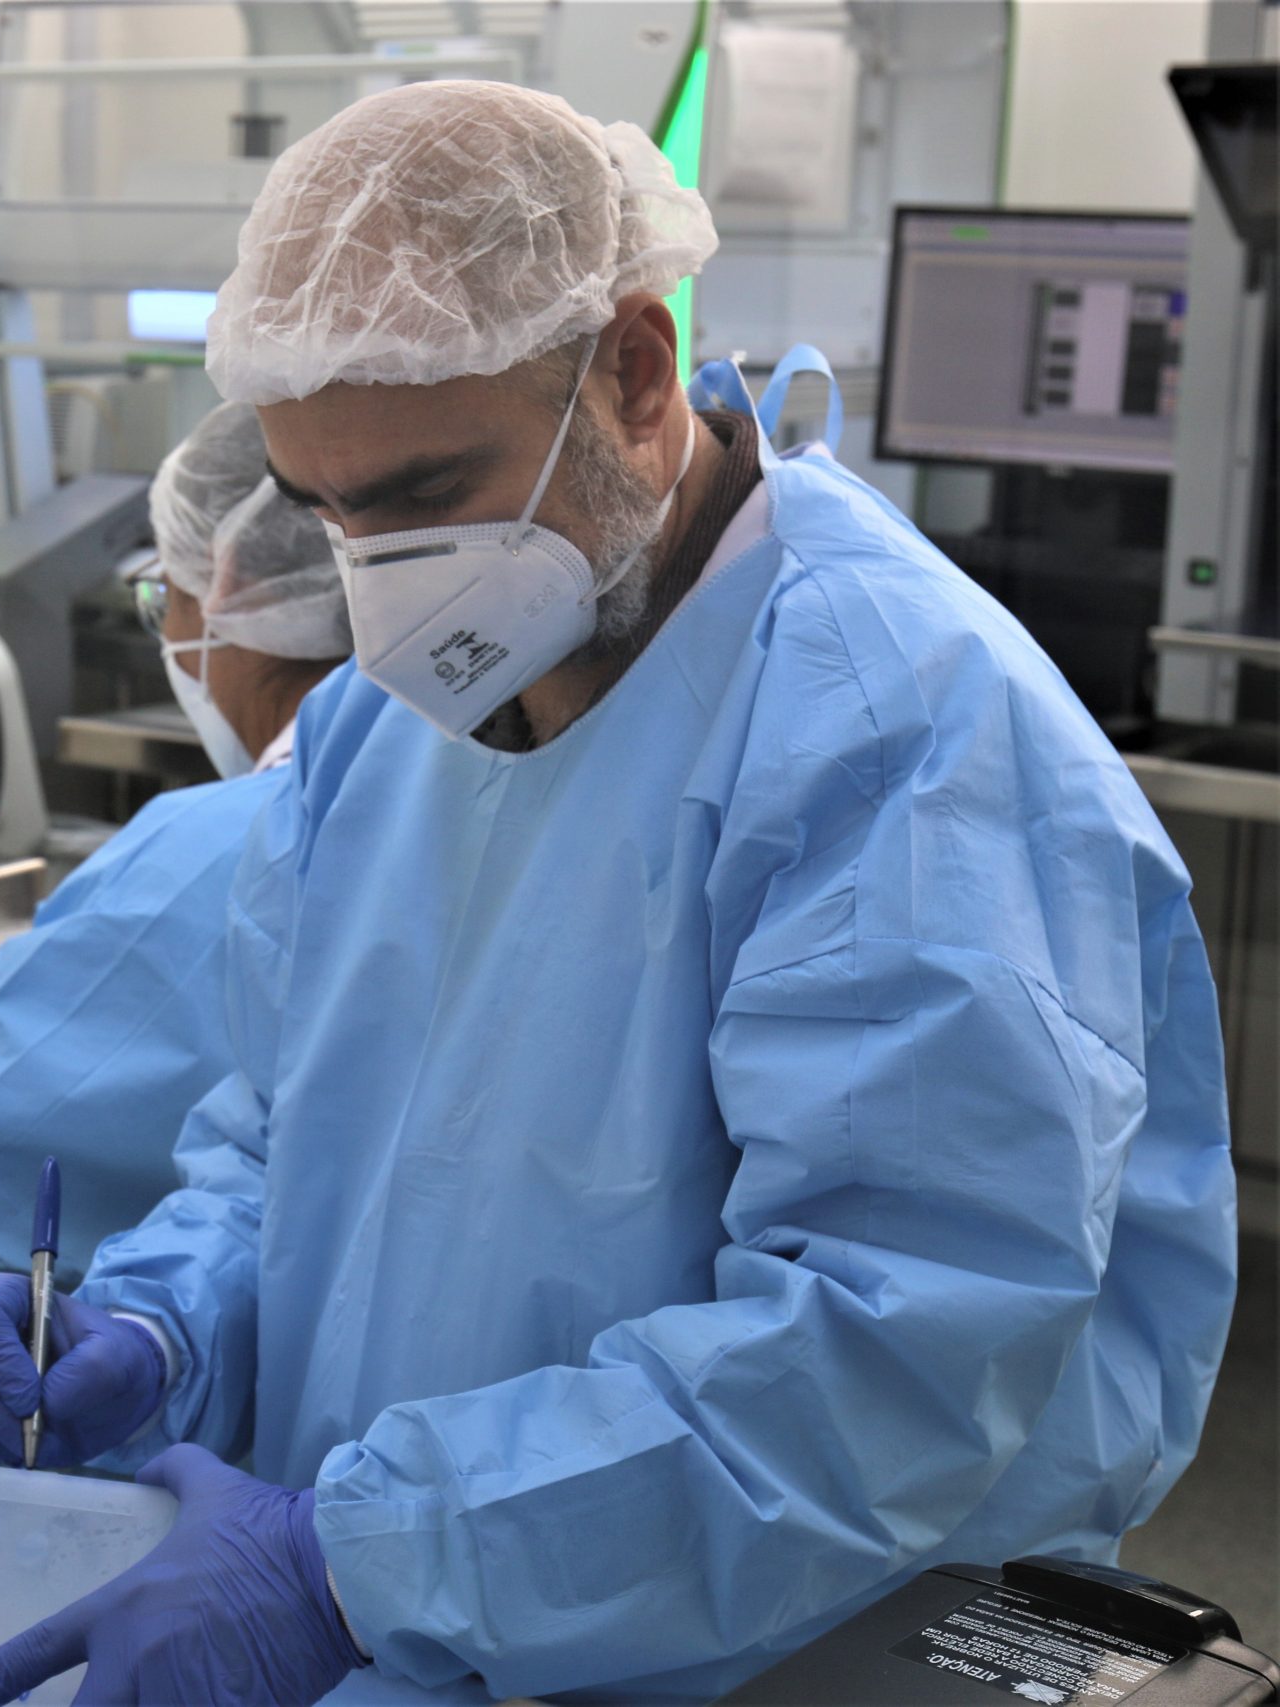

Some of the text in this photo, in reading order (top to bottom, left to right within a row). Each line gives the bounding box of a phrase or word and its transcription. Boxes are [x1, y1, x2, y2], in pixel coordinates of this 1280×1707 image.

[429, 629, 466, 660] Saúde
[924, 1626, 943, 1634] UM
[941, 1632, 966, 1641] POR
[918, 1630, 970, 1648] ELÉTRICA
[964, 1639, 1012, 1656] BATERIA
[970, 1635, 1009, 1649] HORAS
[930, 1639, 983, 1658] NOBREAK
[968, 1646, 1000, 1658] REDE
[926, 1652, 1002, 1682] ATENÇÃO:
[992, 1659, 1042, 1677] UTILIZAR
[1007, 1659, 1076, 1683] CONECTADO
[1018, 1657, 1095, 1684] RECARREGAR
[1037, 1658, 1089, 1676] PERÍODO
[1040, 1675, 1059, 1683] DE
[1057, 1681, 1097, 1696] ANTES
[1093, 1682, 1125, 1695] PARA
